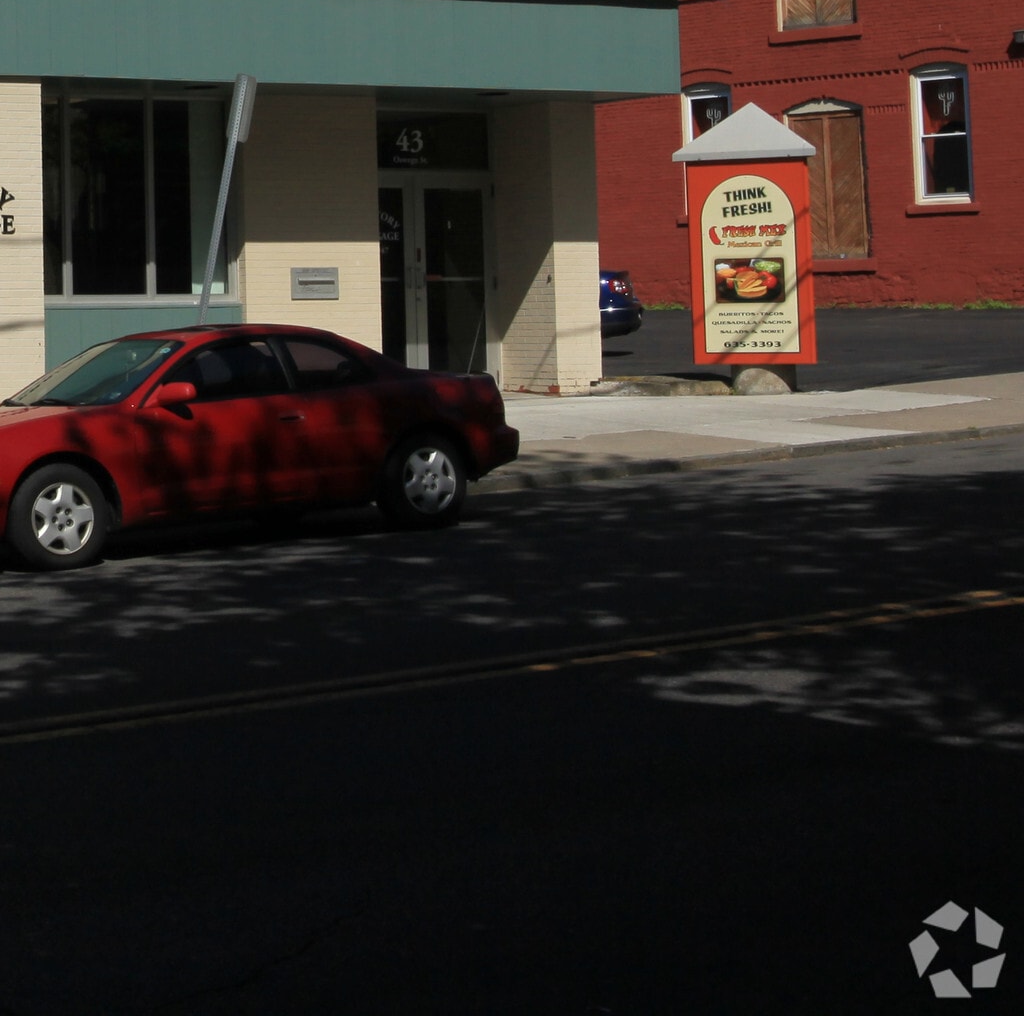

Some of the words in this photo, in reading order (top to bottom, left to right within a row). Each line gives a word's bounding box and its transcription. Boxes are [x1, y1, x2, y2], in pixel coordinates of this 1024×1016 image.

[395, 127, 424, 153] 43
[723, 186, 767, 202] THINK
[721, 202, 772, 218] FRESH!
[721, 224, 756, 238] FRESH
[727, 240, 762, 248] Mexican
[764, 239, 782, 247] Grill
[723, 340, 782, 348] 635-3393
